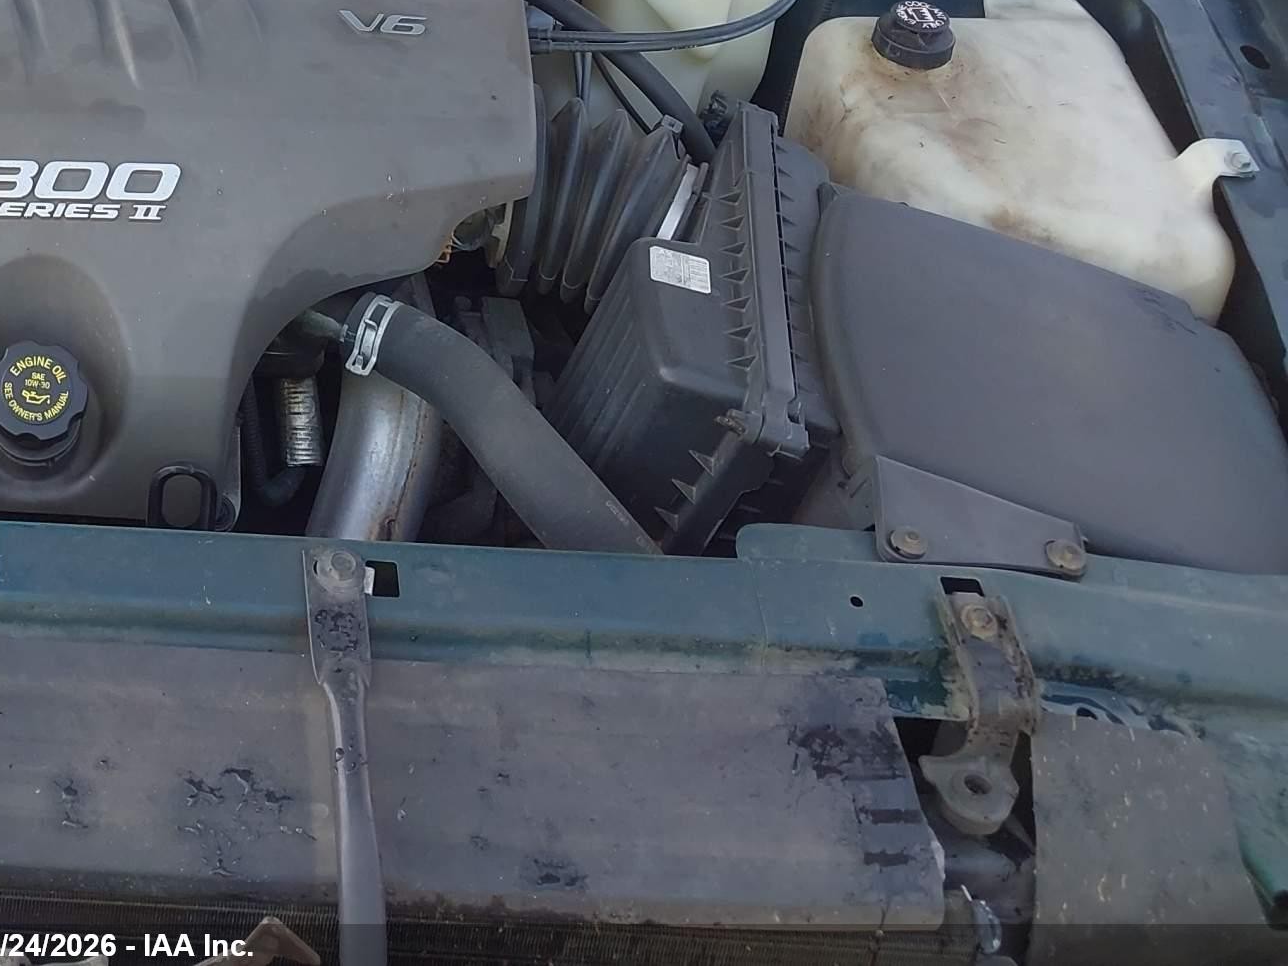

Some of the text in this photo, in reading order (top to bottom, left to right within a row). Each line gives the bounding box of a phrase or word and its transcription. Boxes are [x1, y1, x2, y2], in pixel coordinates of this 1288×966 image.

[338, 10, 427, 35] V6
[128, 204, 167, 221] II
[10, 356, 67, 384] ENGINE OIL
[31, 372, 46, 381] SAE
[25, 379, 50, 389] 10W-30
[4, 382, 69, 420] SEE OWNER'S MANUAL
